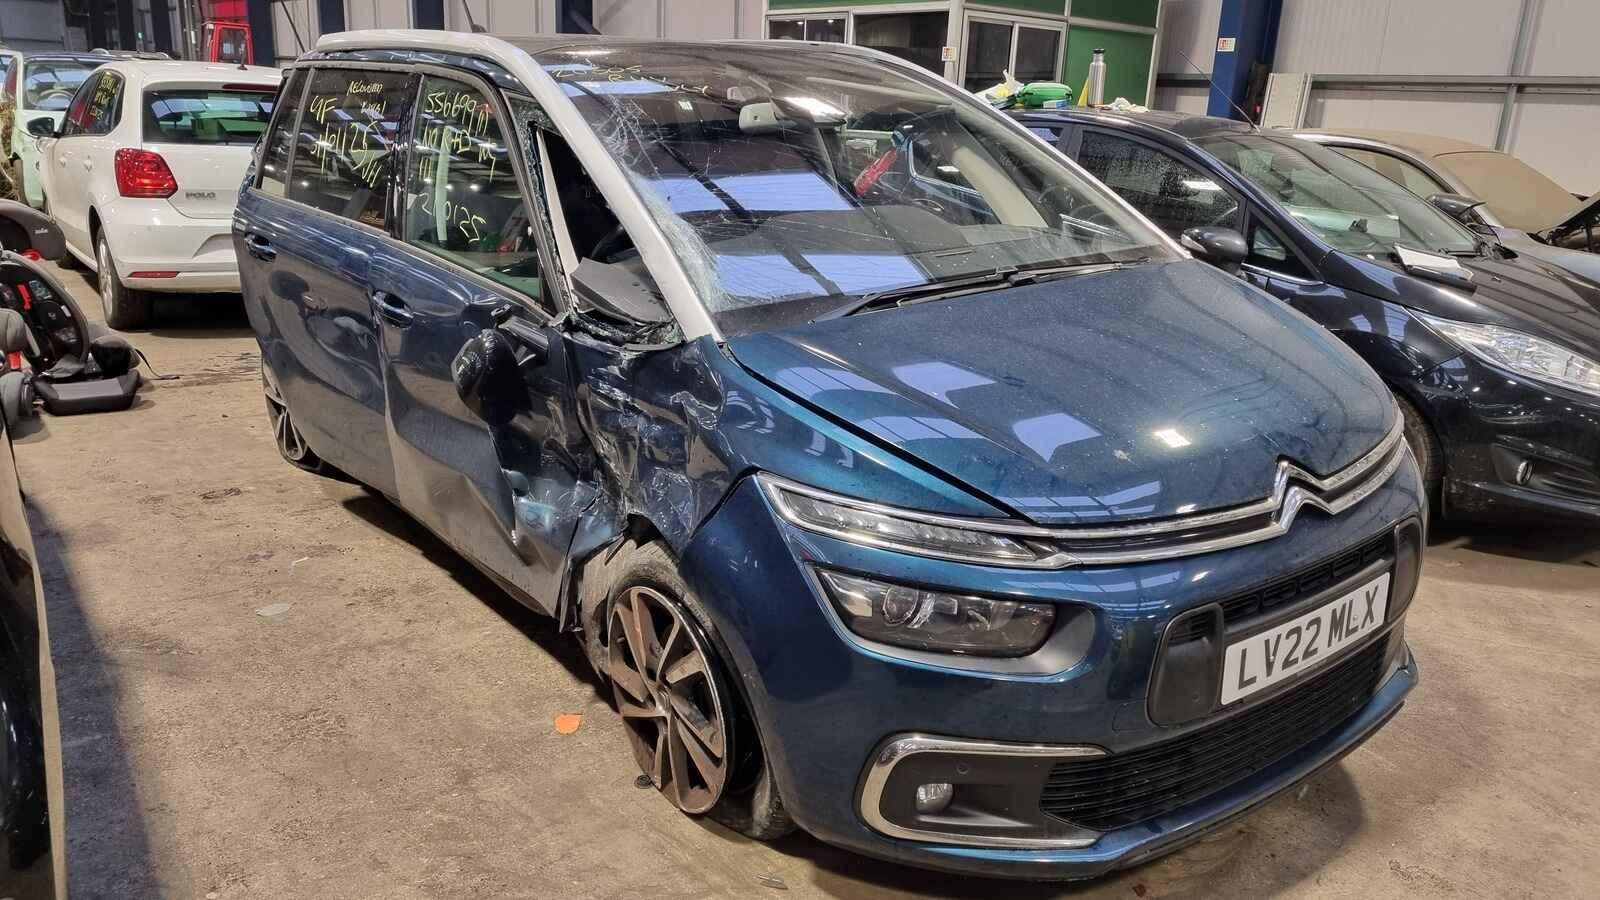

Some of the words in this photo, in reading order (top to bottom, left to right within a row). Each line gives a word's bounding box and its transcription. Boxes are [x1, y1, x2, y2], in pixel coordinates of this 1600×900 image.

[185, 191, 216, 199] POLO
[1237, 616, 1322, 690] LV22
[1327, 585, 1379, 649] MLX
